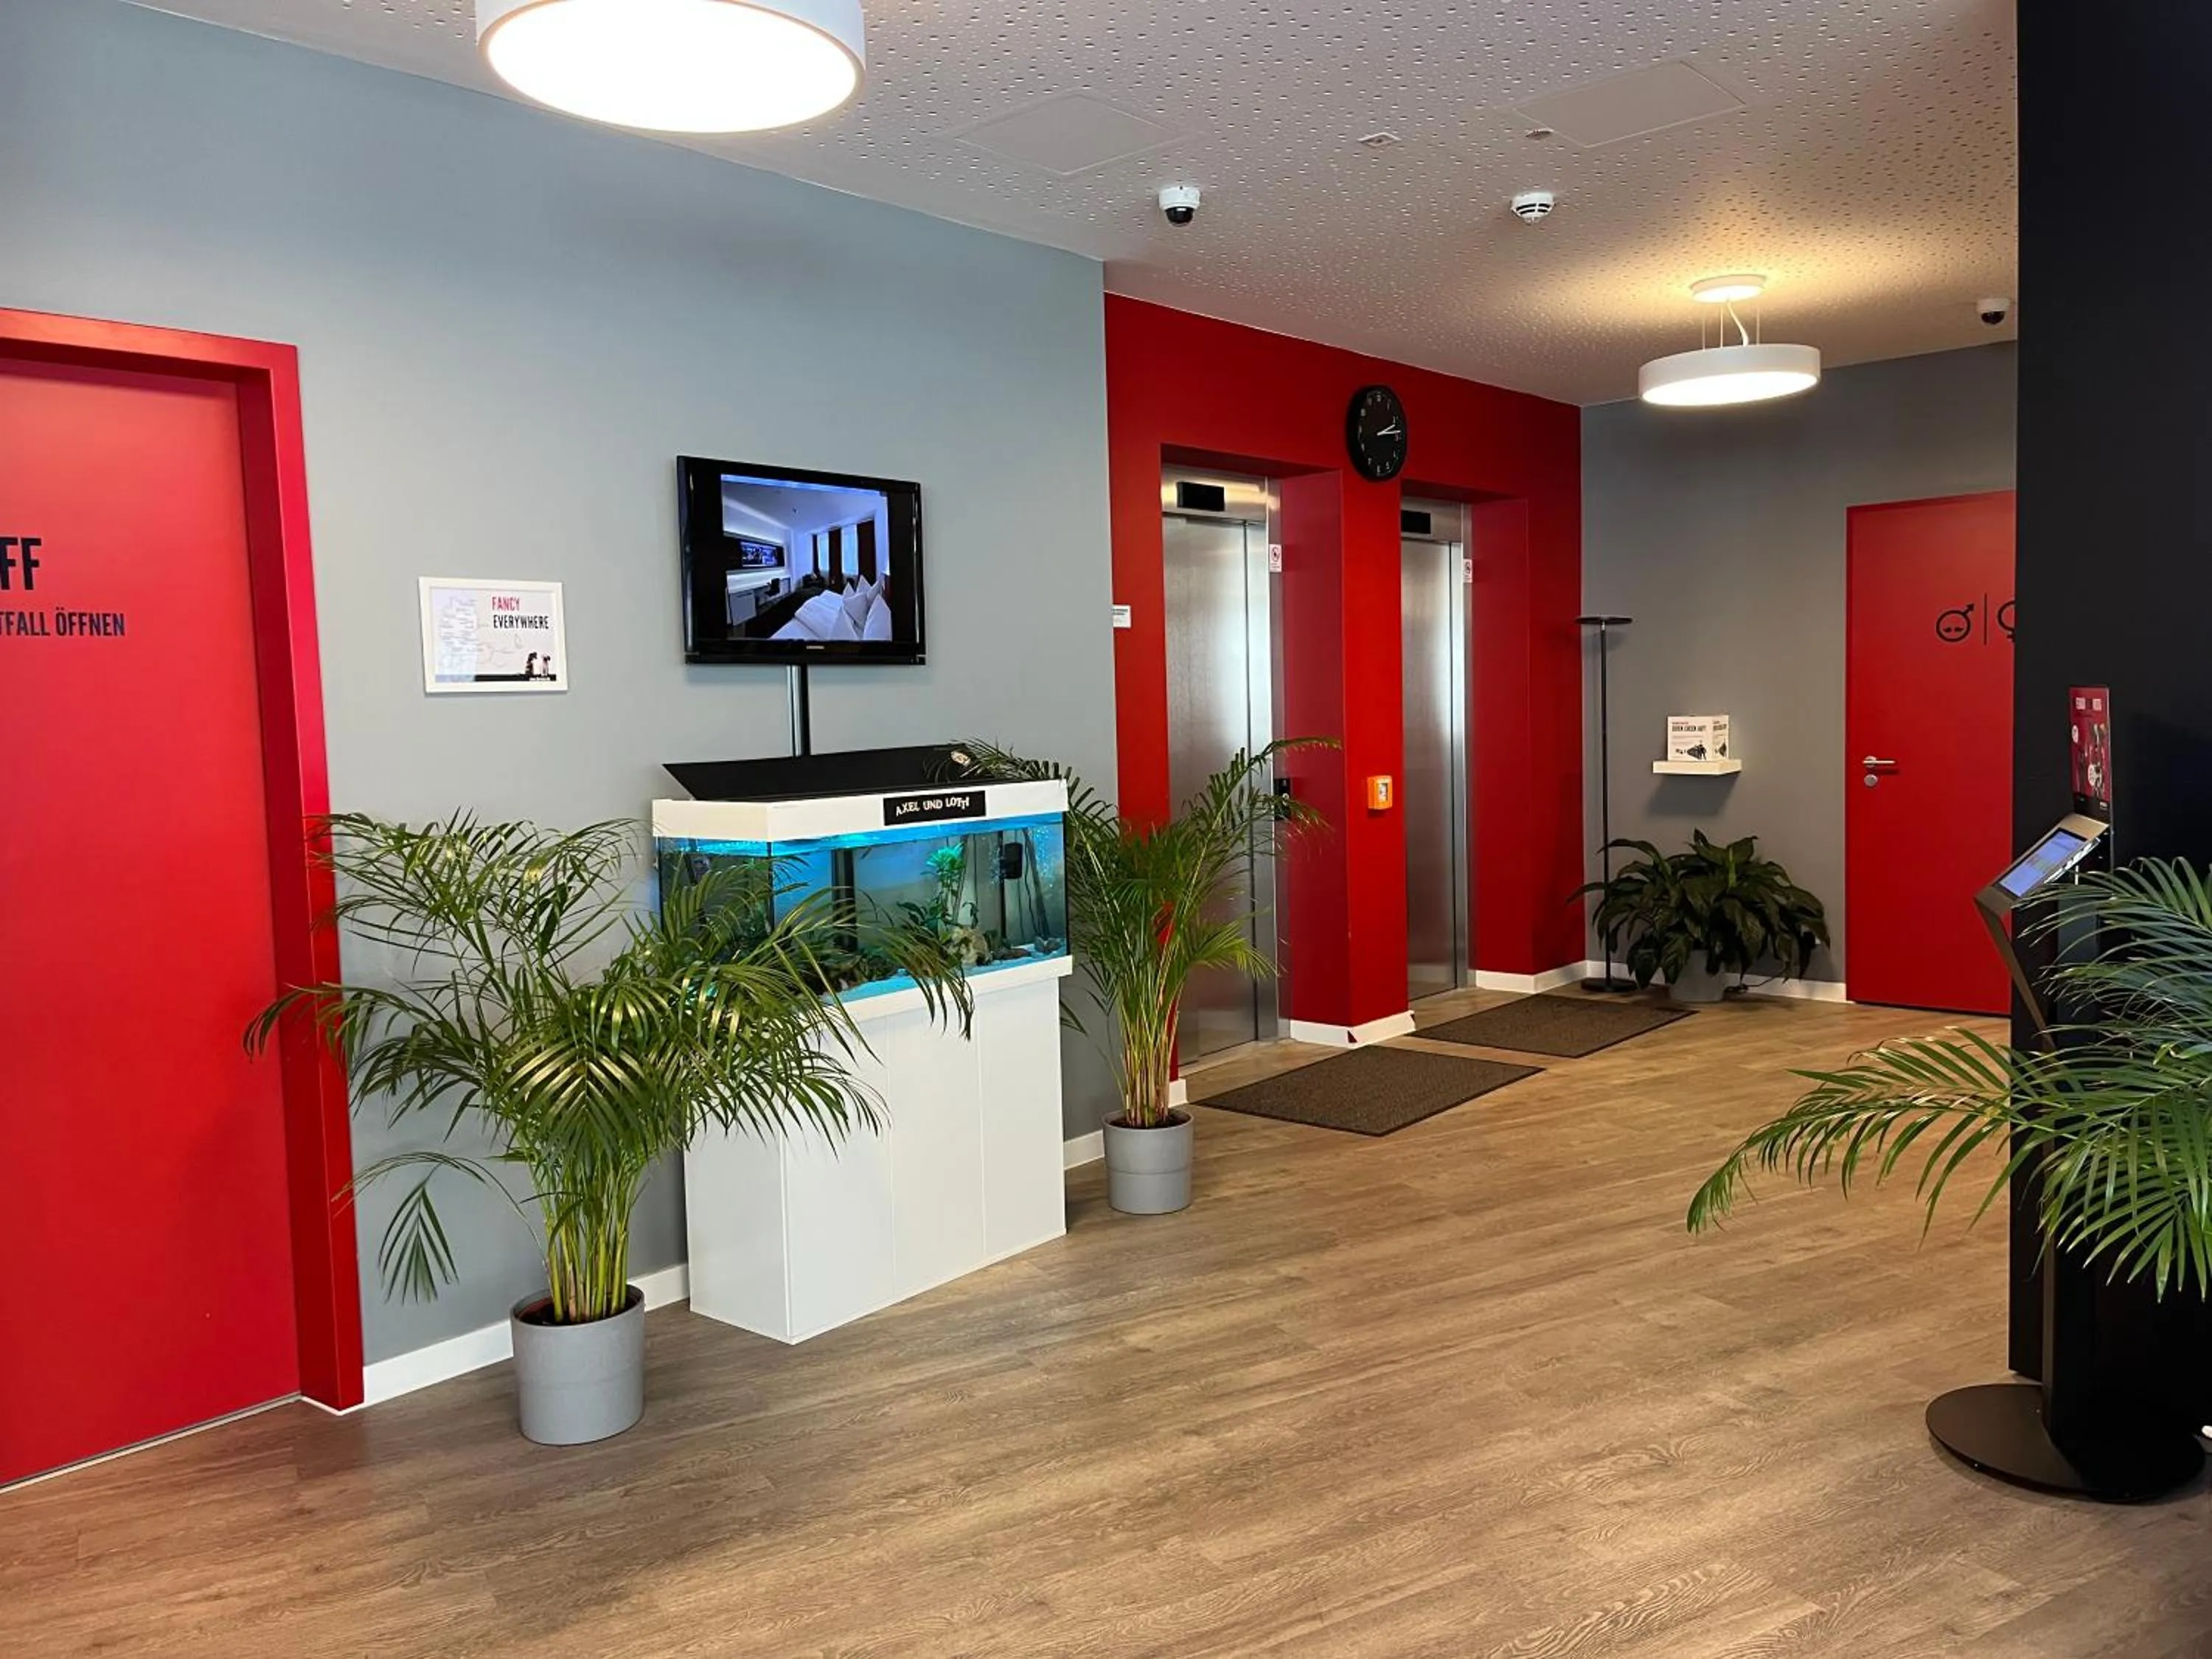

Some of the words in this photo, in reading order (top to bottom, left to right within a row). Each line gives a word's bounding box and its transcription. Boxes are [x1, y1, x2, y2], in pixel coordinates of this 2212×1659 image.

[492, 597, 520, 611] FANCY
[55, 608, 125, 636] ÖFFNEN
[493, 615, 549, 629] EVERYWHERE
[896, 801, 920, 816] AXEL
[922, 799, 943, 810] UND
